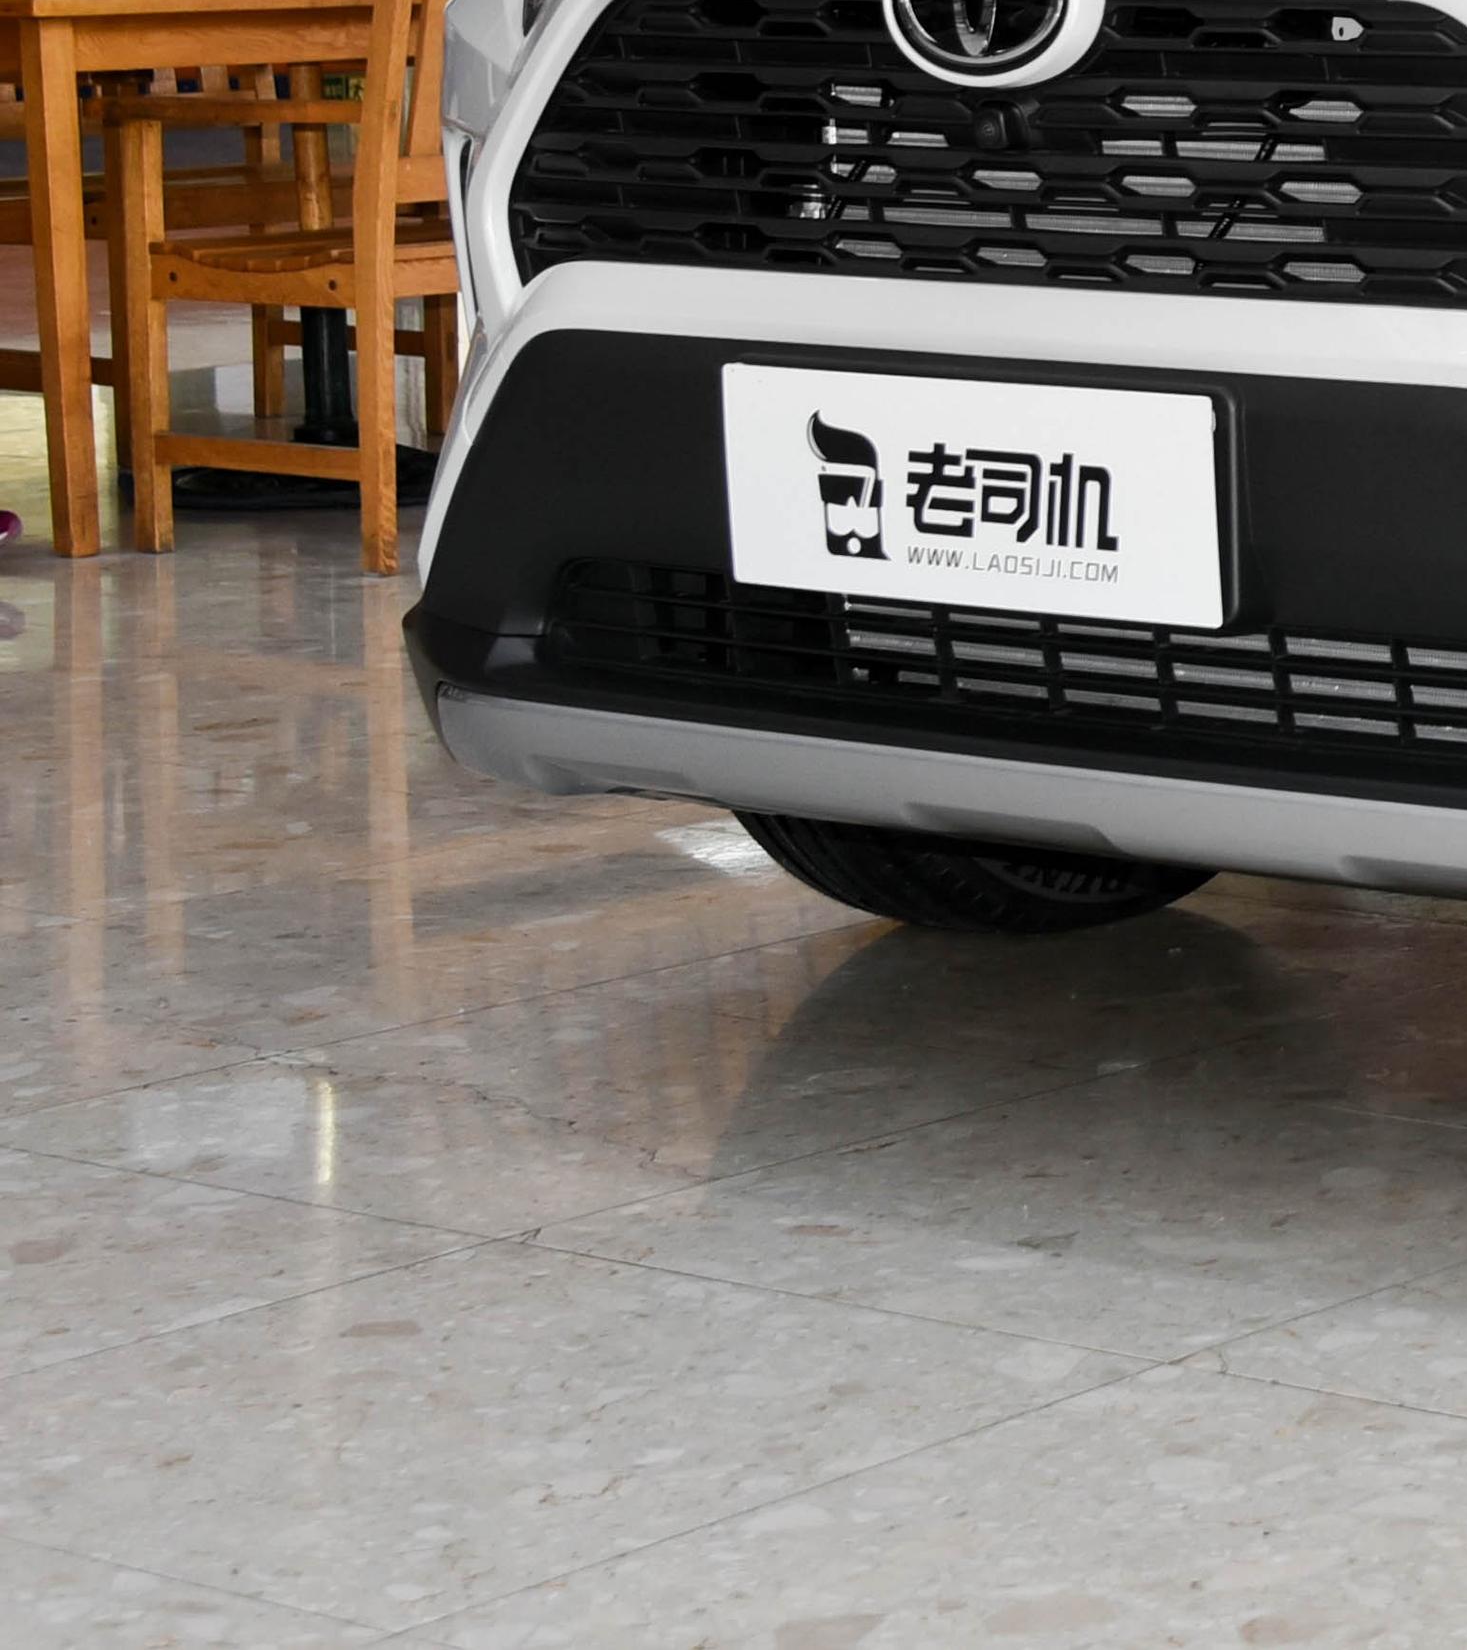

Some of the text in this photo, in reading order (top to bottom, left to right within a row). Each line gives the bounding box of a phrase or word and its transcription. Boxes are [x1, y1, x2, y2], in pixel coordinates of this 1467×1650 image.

[905, 442, 1120, 552] 老司机
[906, 545, 1120, 584] WWW.LAOSIJI.COM
